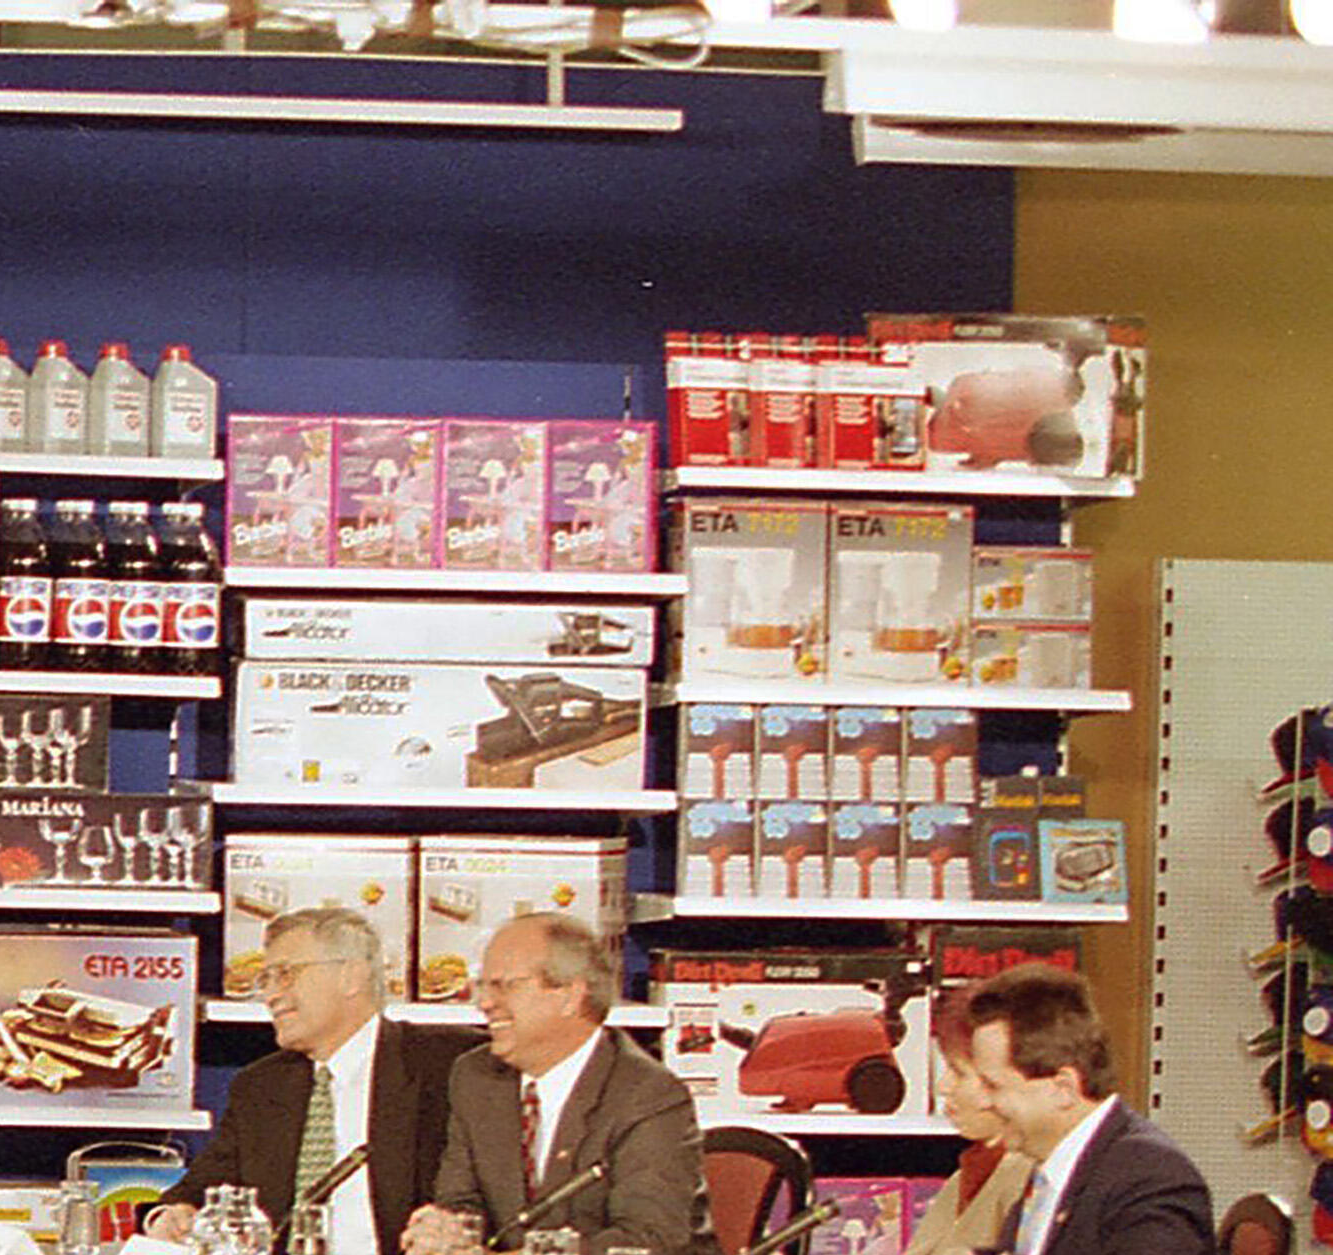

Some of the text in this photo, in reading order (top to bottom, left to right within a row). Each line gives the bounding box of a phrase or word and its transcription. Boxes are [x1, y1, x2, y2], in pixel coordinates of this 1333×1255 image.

[691, 512, 739, 532] ETA
[837, 516, 885, 537] ETA
[234, 521, 287, 546] Barbie
[278, 673, 331, 691] BLACK
[346, 674, 410, 692] DECKER
[230, 854, 263, 869] ETA
[426, 856, 458, 871] ETA
[85, 956, 185, 978] ETA 2155
